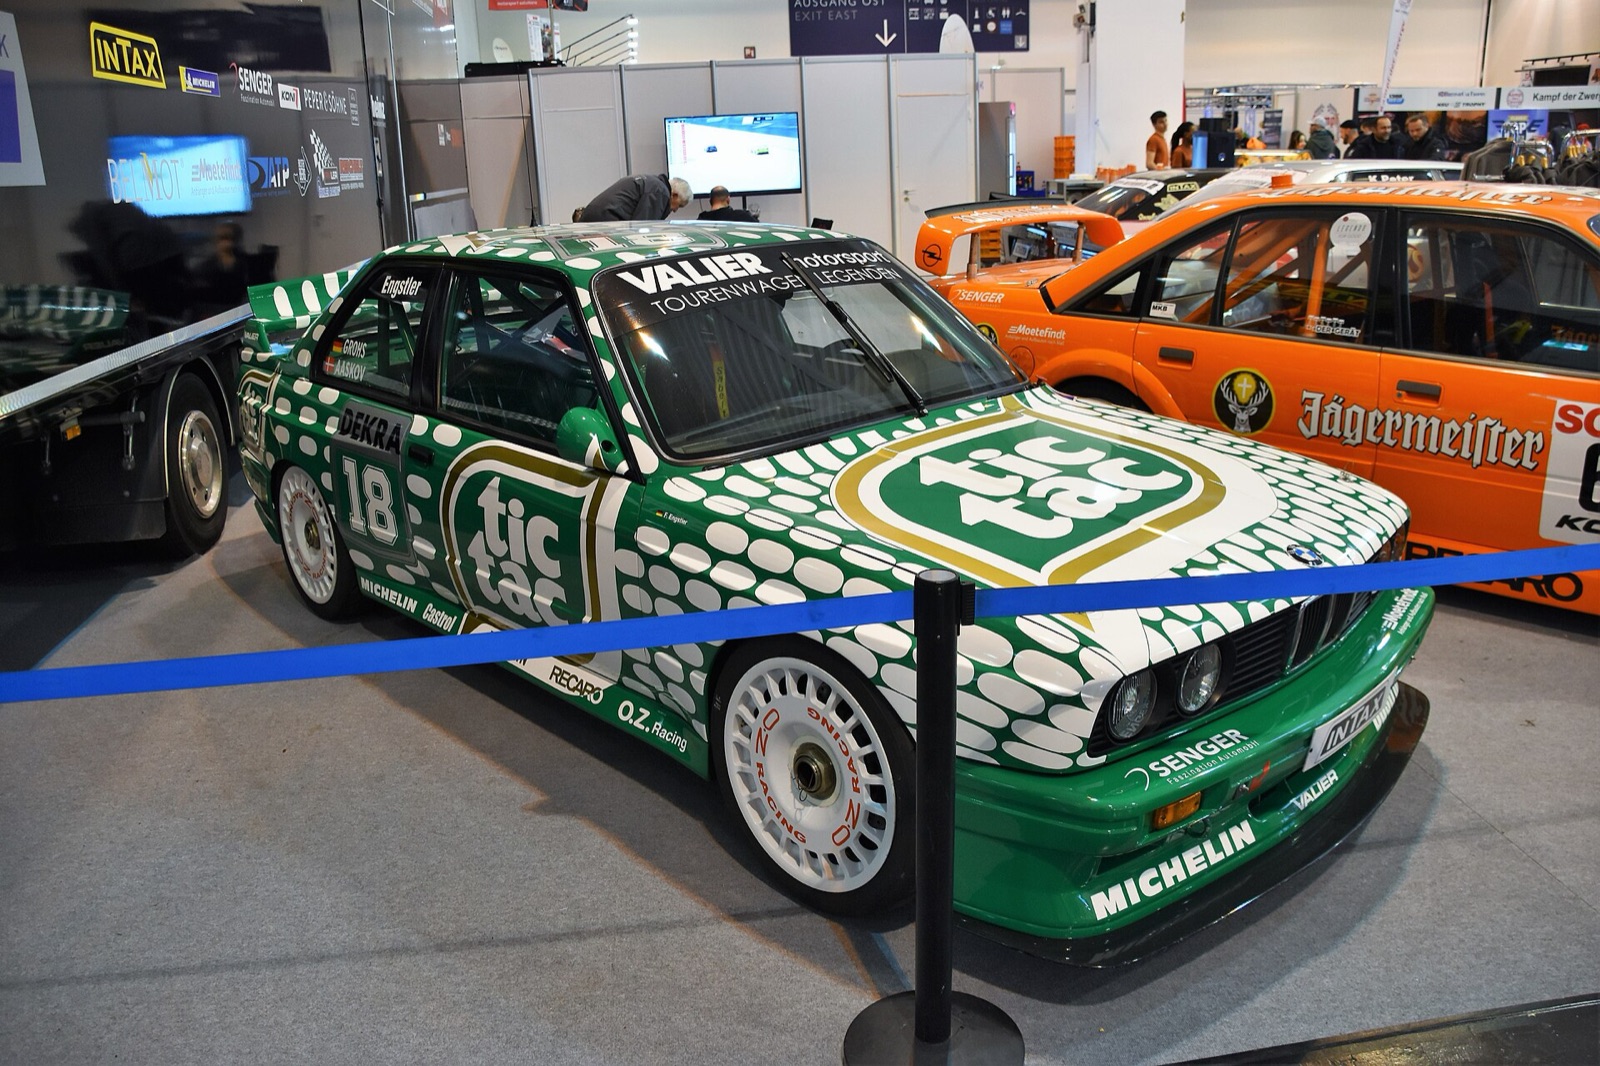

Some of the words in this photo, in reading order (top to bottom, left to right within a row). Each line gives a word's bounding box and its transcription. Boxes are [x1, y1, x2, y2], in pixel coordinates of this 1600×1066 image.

[794, 0, 857, 8] AUSGANG
[794, 11, 822, 21] EXIT
[827, 10, 858, 20] EAST
[97, 37, 159, 79] INTAX
[192, 77, 215, 89] MICHELIN
[238, 66, 273, 96] SENGER
[303, 88, 323, 110] PEPER
[1533, 92, 1561, 103] Kampf
[1565, 93, 1577, 101] der
[270, 157, 290, 188] ATP
[381, 275, 422, 299] Engstler
[616, 252, 773, 295] VALIER
[813, 267, 903, 285] LEGENDEN
[959, 289, 1005, 304] SENGER
[342, 338, 368, 359] GROHS
[1016, 323, 1067, 340] Moetefindt
[333, 358, 367, 382] AASKOV
[338, 408, 402, 455] DEKRA
[919, 435, 1106, 497] tic
[342, 455, 398, 546] 18
[960, 457, 1184, 539] tac
[477, 476, 562, 579] tic
[467, 530, 570, 627] tac
[360, 577, 418, 614] MICHELIN
[422, 602, 457, 633] Castrol
[549, 665, 604, 705] RECARO
[651, 721, 688, 753] Racing
[1325, 689, 1386, 751] INTAX
[807, 707, 861, 794] RACING
[1148, 728, 1250, 778] SENGER
[1166, 759, 1218, 785] Faszination
[1218, 739, 1260, 763] Automobil
[756, 762, 807, 844] RACING
[1293, 768, 1339, 811] VALIER
[1090, 819, 1257, 921] MICHELIN
